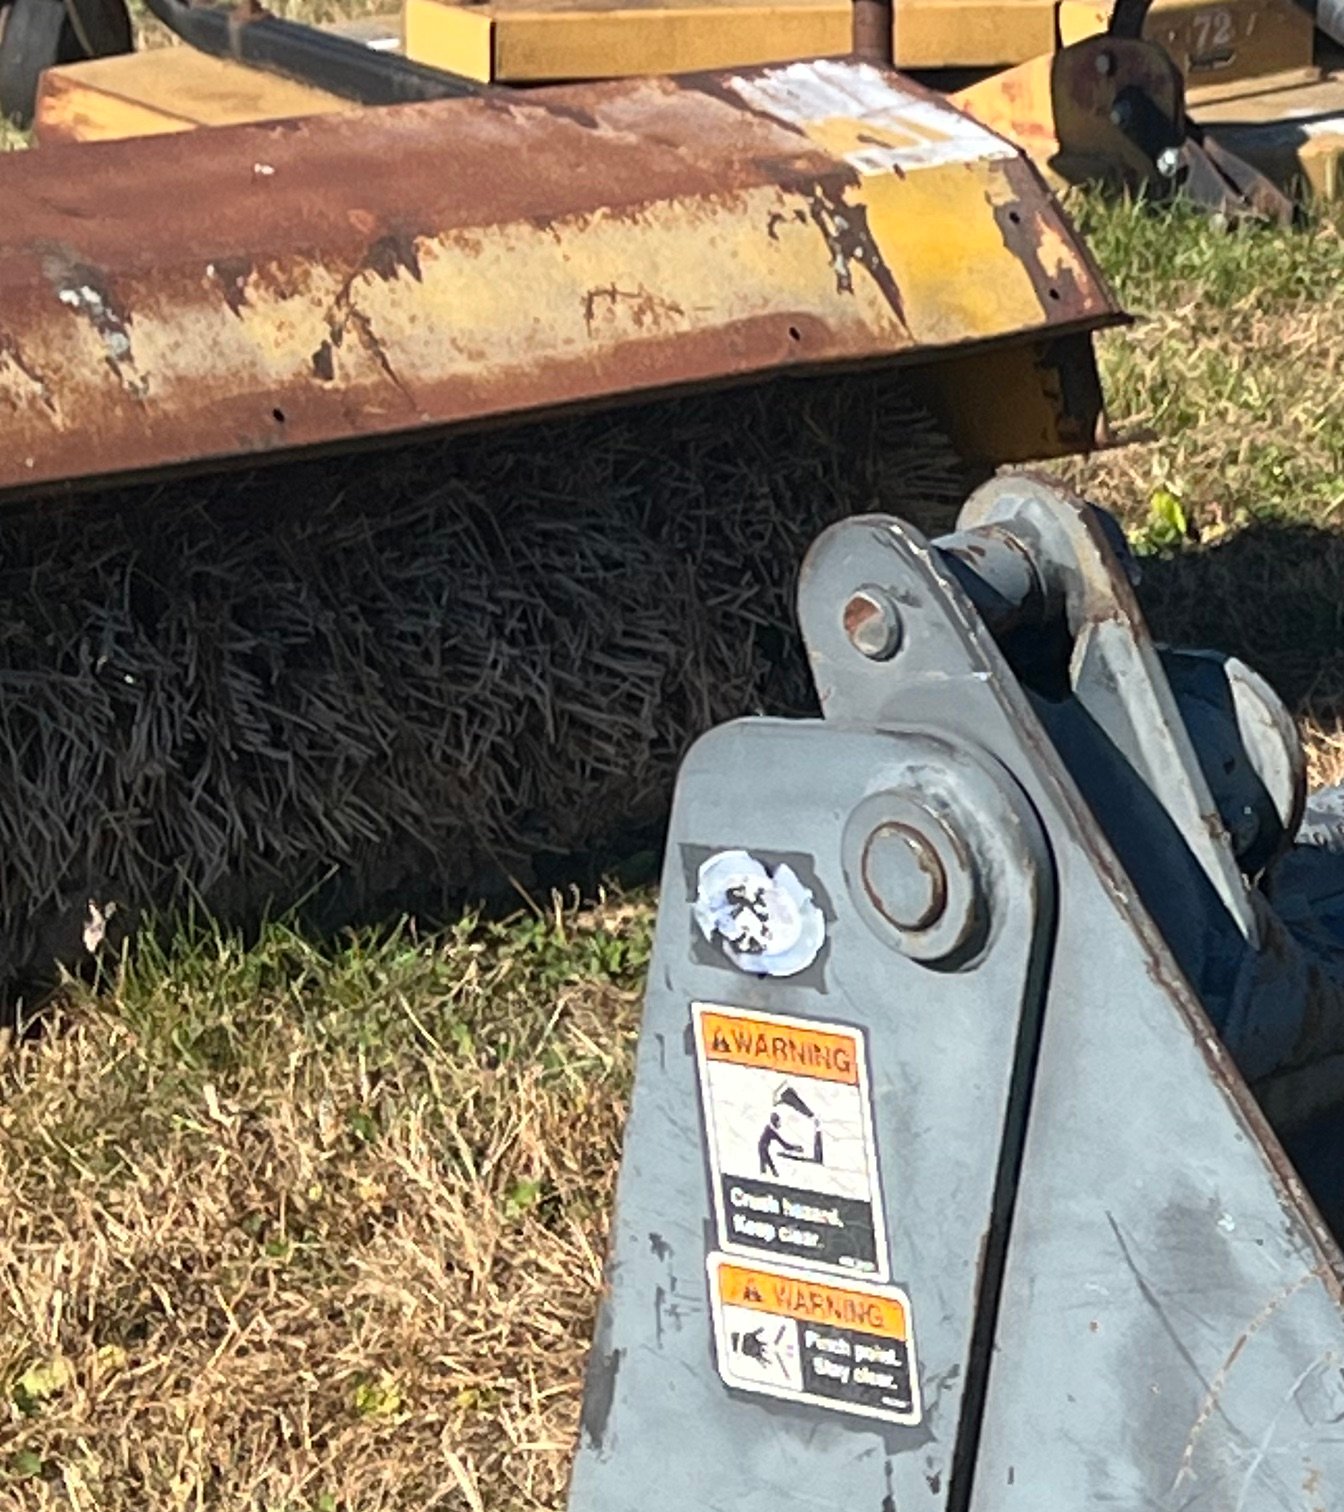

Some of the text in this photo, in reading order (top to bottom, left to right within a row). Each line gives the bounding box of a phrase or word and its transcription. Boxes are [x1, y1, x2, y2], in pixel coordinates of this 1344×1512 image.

[731, 1026, 850, 1073] WARNING
[730, 1186, 780, 1214] Crush
[732, 1213, 776, 1242] Keep
[774, 1282, 884, 1328] WARNING
